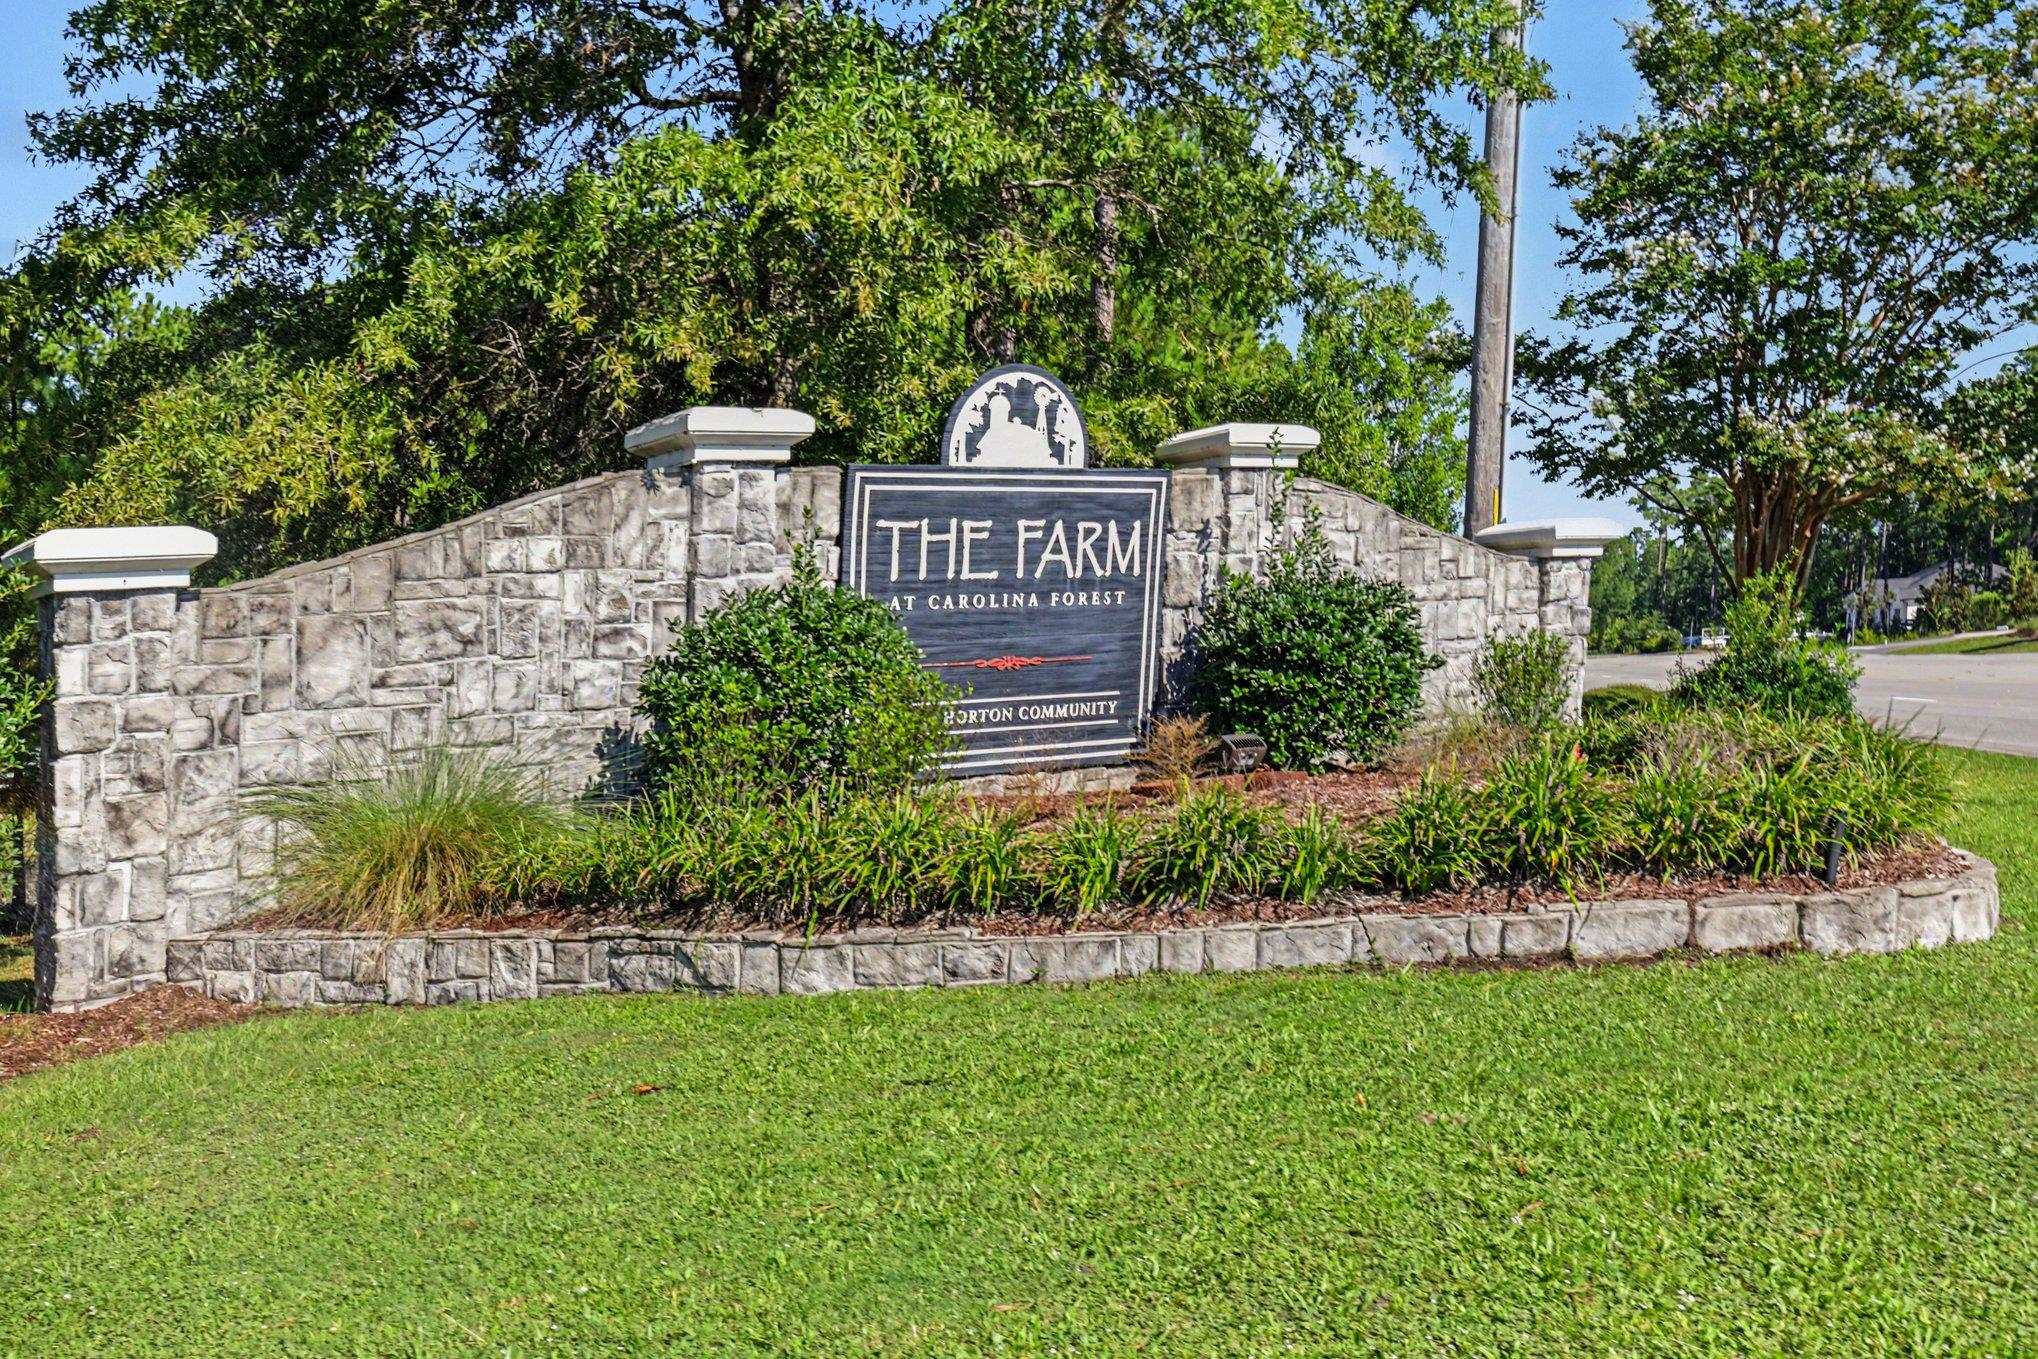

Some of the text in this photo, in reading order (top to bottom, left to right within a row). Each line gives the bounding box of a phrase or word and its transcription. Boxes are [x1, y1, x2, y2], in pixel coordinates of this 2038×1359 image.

[876, 518, 1141, 581] THE FARM
[890, 591, 1126, 611] AT CAROLINA FOREST
[944, 701, 1118, 725] HORTON COMMUNITY
